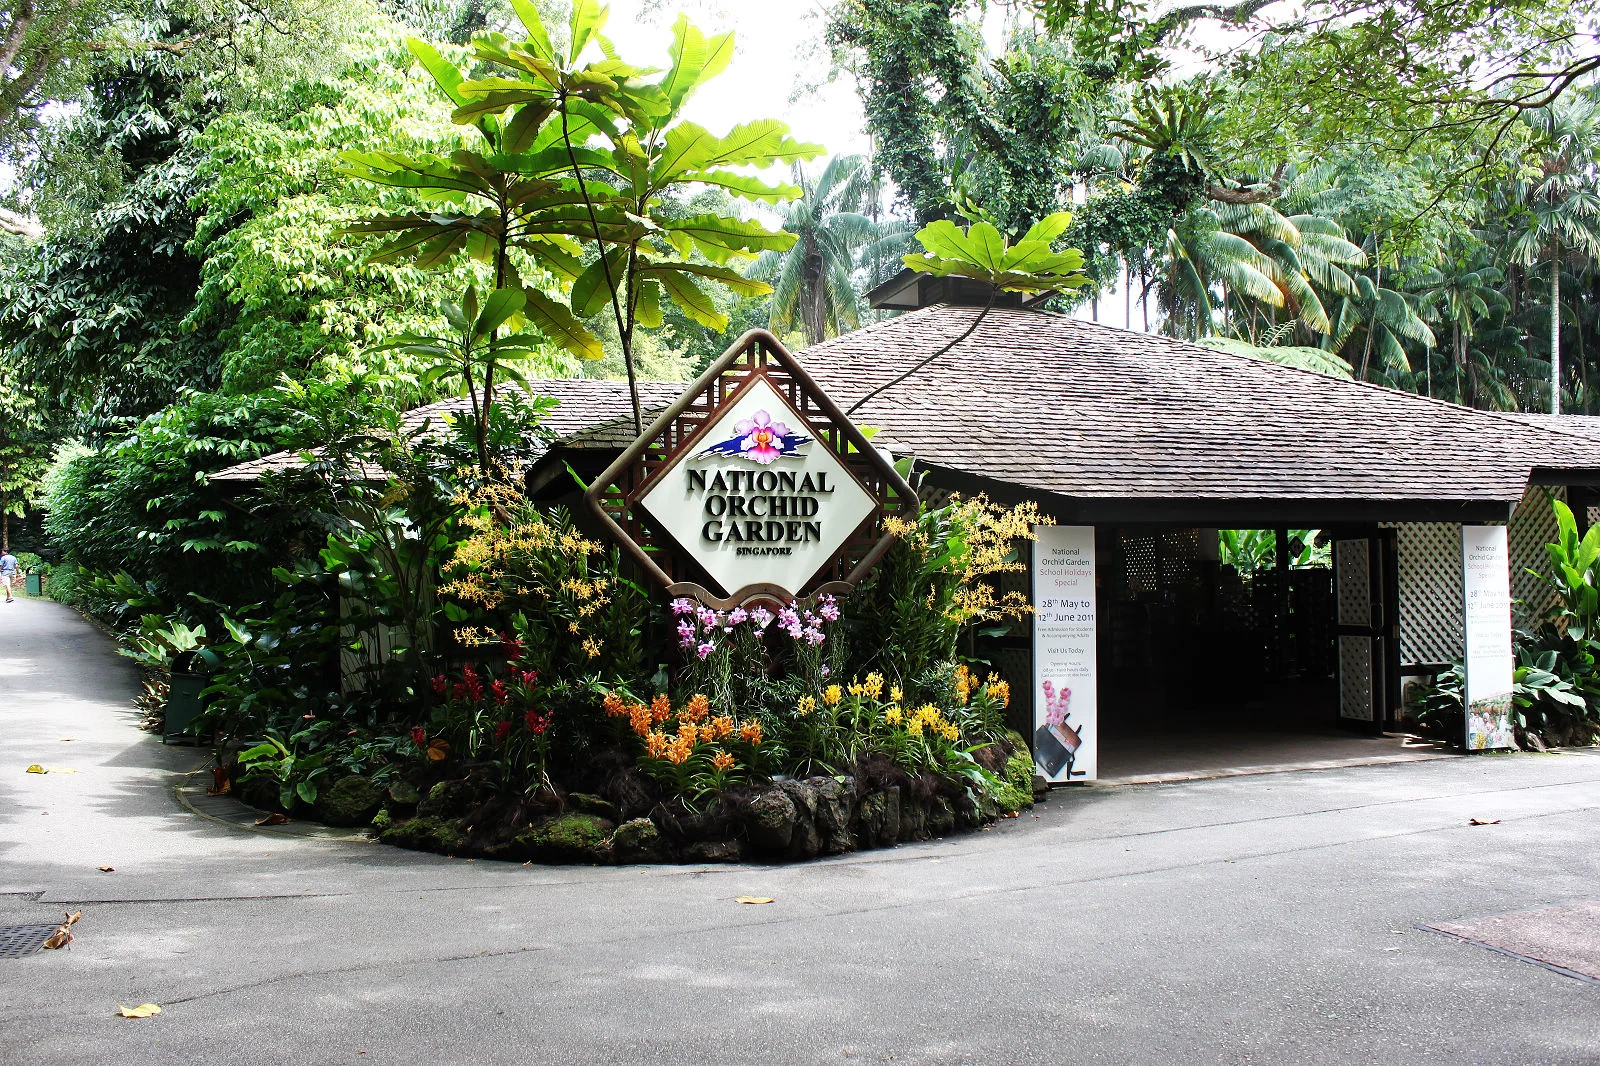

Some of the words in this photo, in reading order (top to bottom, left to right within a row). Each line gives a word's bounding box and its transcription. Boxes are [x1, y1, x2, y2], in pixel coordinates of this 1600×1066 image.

[687, 469, 835, 493] NATIONAL
[704, 494, 819, 517] ORCHID
[702, 520, 822, 542] GARDEN
[736, 547, 792, 556] SINGAPORE
[1041, 558, 1064, 566] Orchid
[1065, 558, 1090, 566] Garden
[1040, 568, 1063, 576] School
[1064, 568, 1092, 577] Holidays
[1054, 579, 1078, 587] Special
[1042, 599, 1059, 608] 28th
[1060, 599, 1079, 610] May
[1080, 600, 1090, 608] to
[1038, 612, 1053, 621] 12th
[1053, 613, 1075, 621] June
